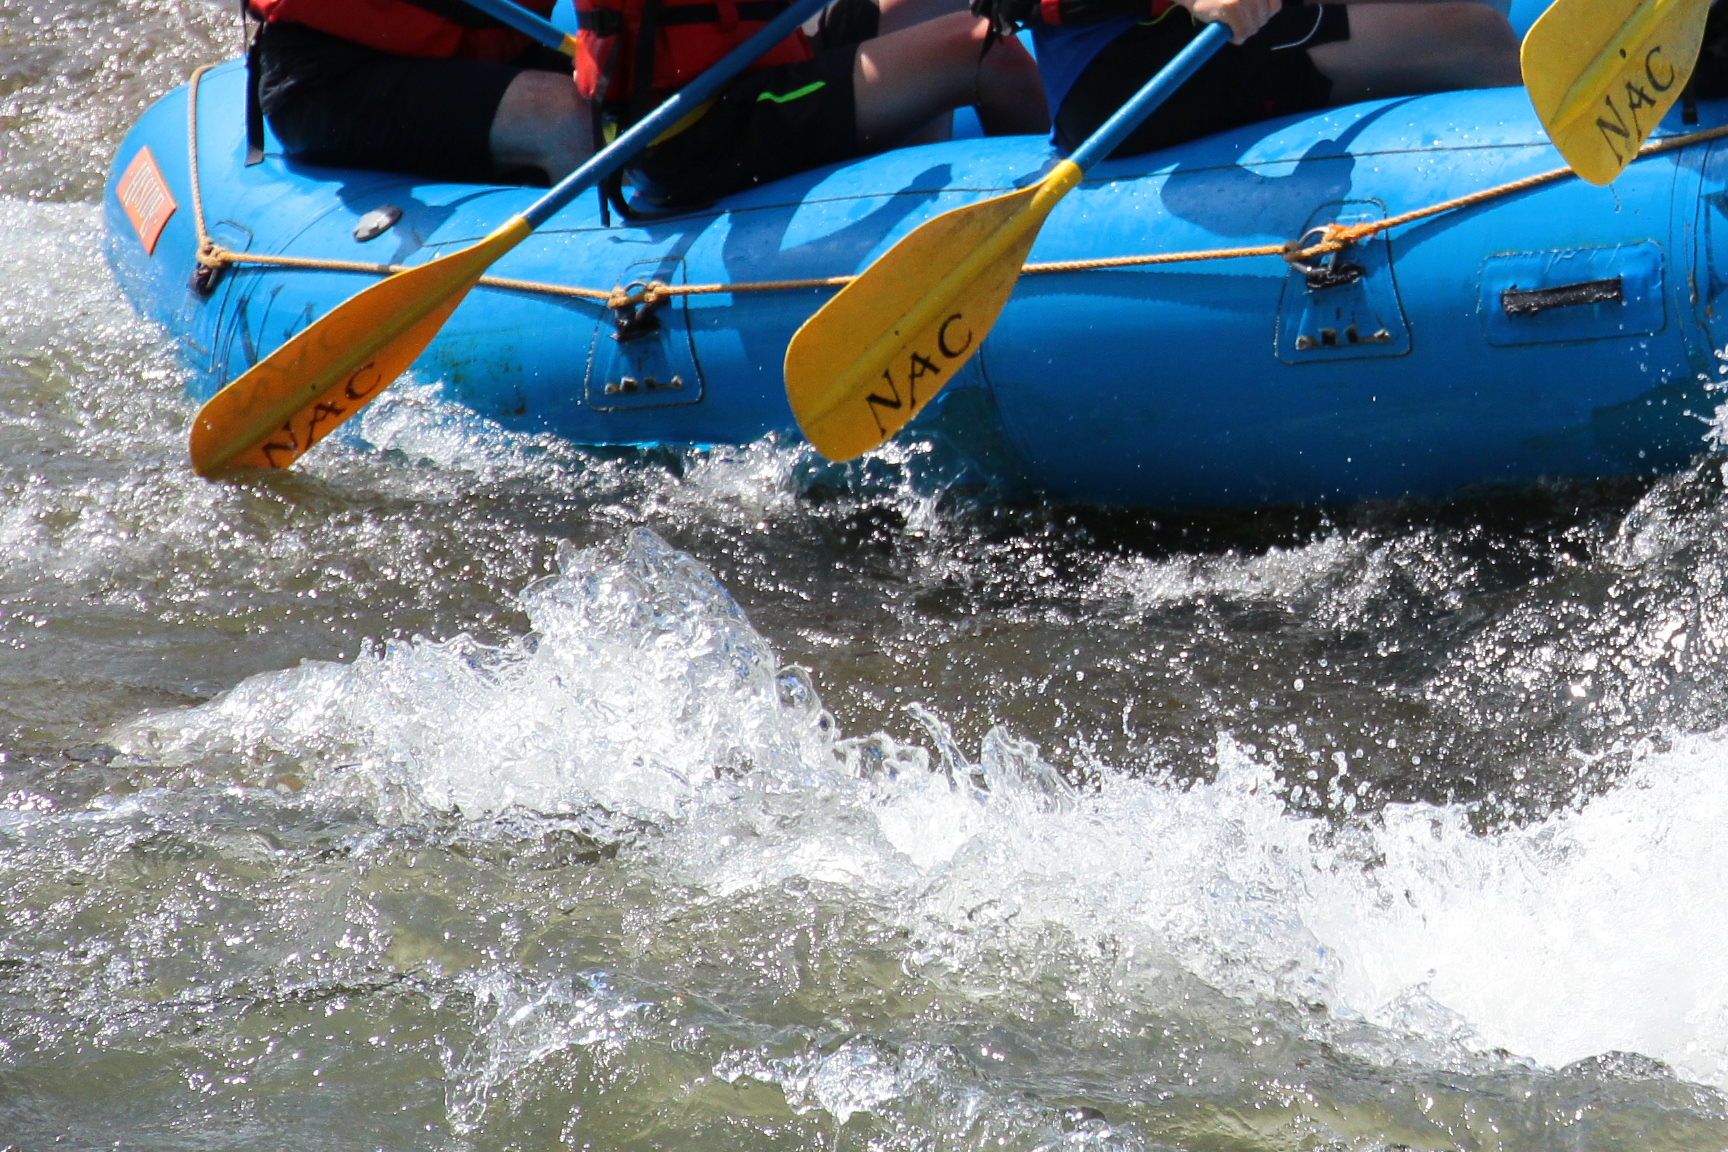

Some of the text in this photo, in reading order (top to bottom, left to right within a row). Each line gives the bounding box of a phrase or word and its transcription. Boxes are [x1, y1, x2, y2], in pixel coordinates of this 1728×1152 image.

[1596, 45, 1675, 167] NAC
[262, 361, 381, 469] NAC
[866, 313, 972, 439] NAC
